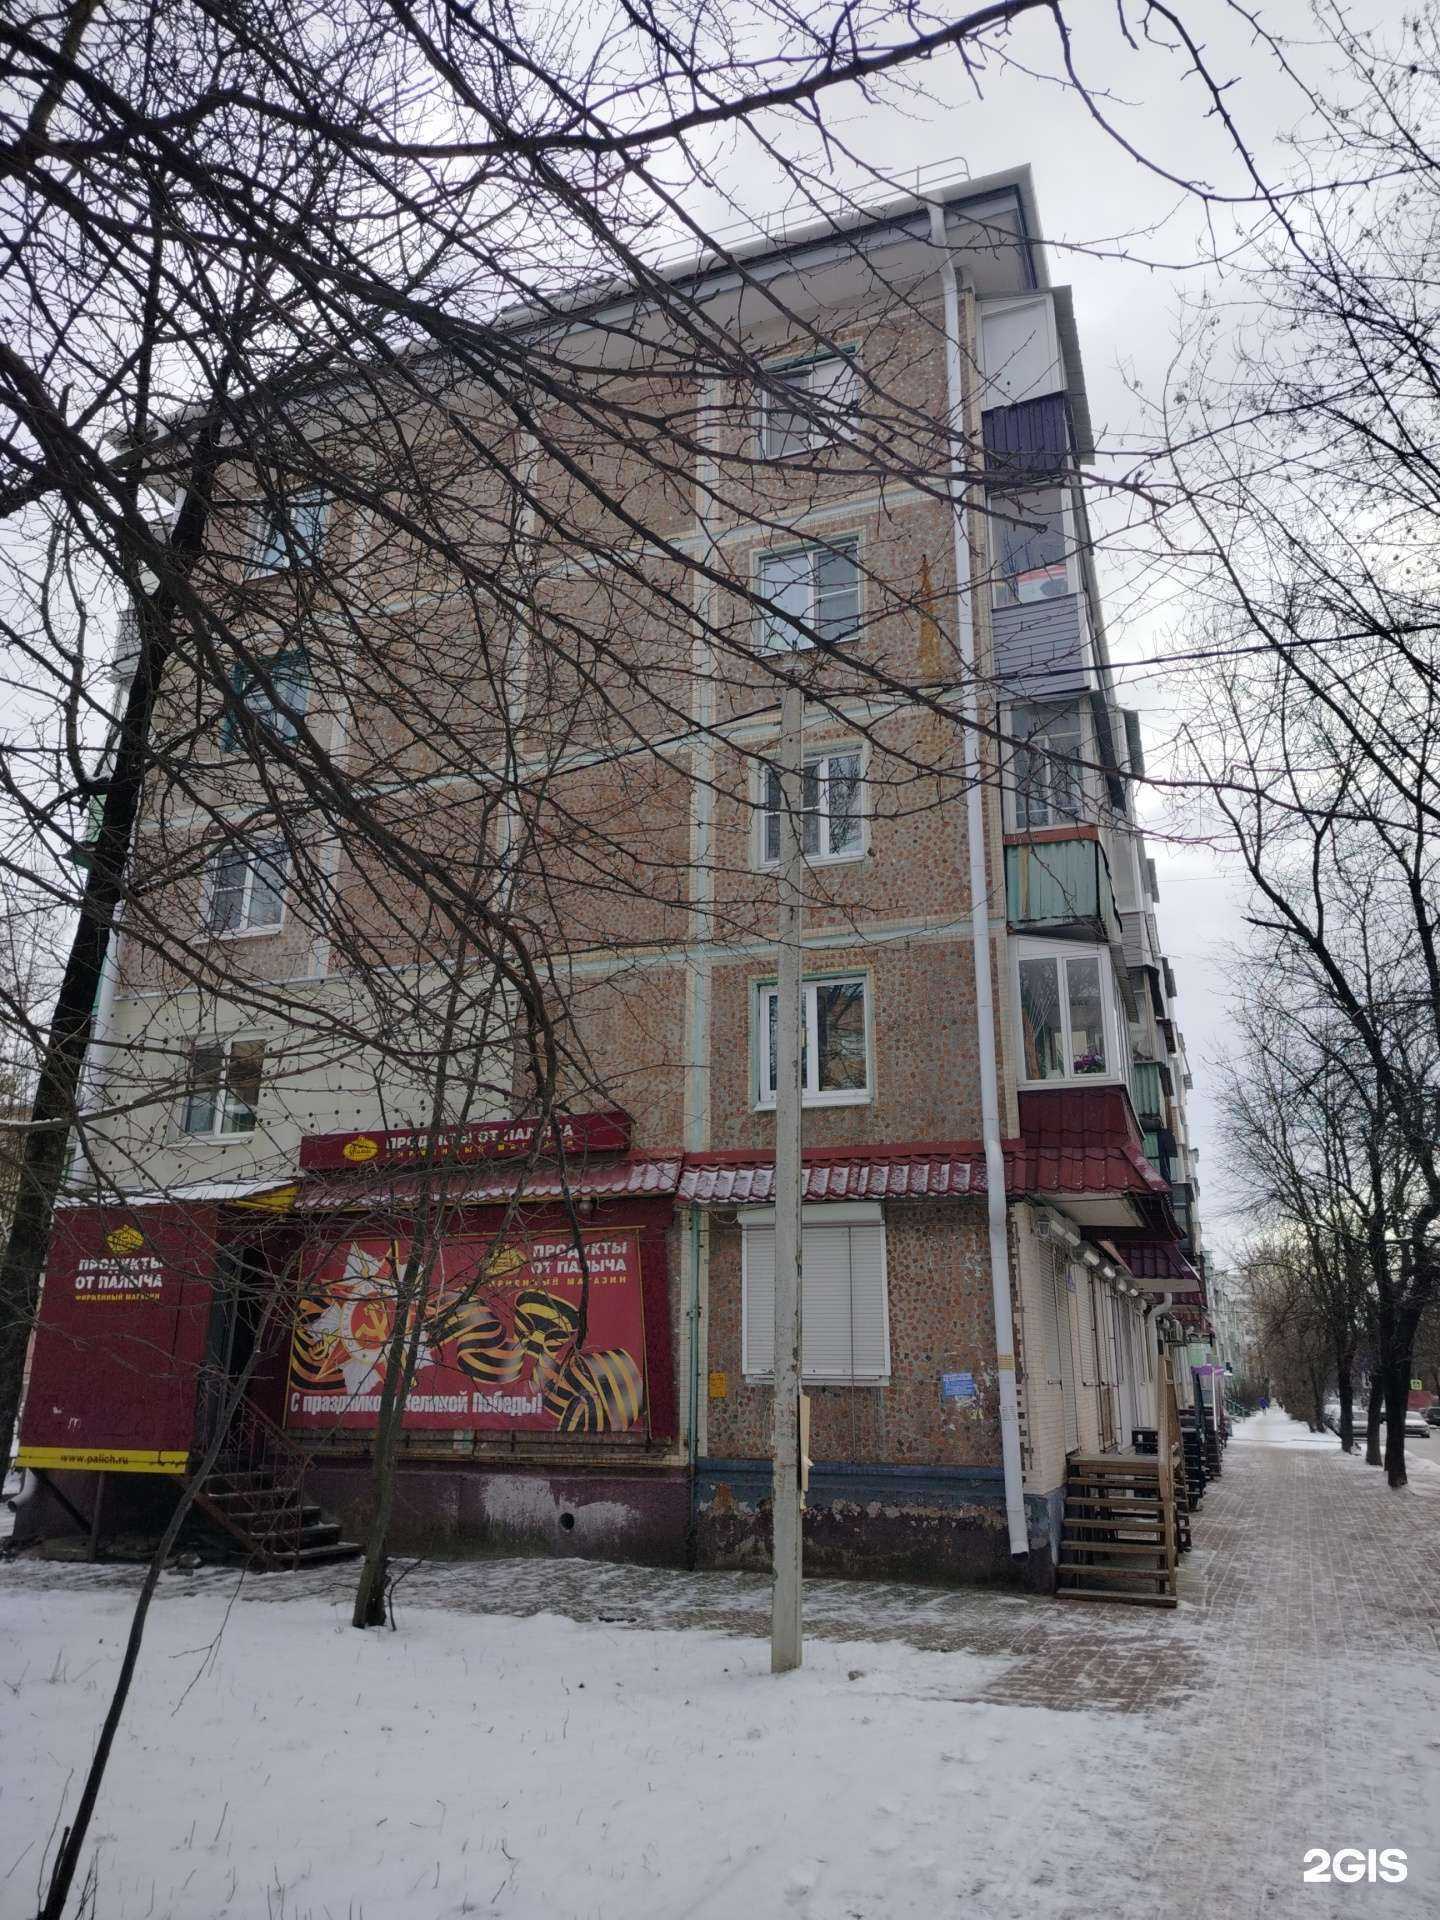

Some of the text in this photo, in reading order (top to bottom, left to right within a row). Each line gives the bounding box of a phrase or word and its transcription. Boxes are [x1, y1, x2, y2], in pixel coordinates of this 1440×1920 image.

[386, 1131, 472, 1150] ПРОДКТЫ
[478, 1129, 499, 1143] ОТ
[531, 1261, 553, 1274] ОТ
[75, 1274, 163, 1290] ОТ ПАЛЫЧА
[290, 1391, 301, 1413] С
[303, 1394, 397, 1415] празднико
[472, 1390, 543, 1416] Победы!
